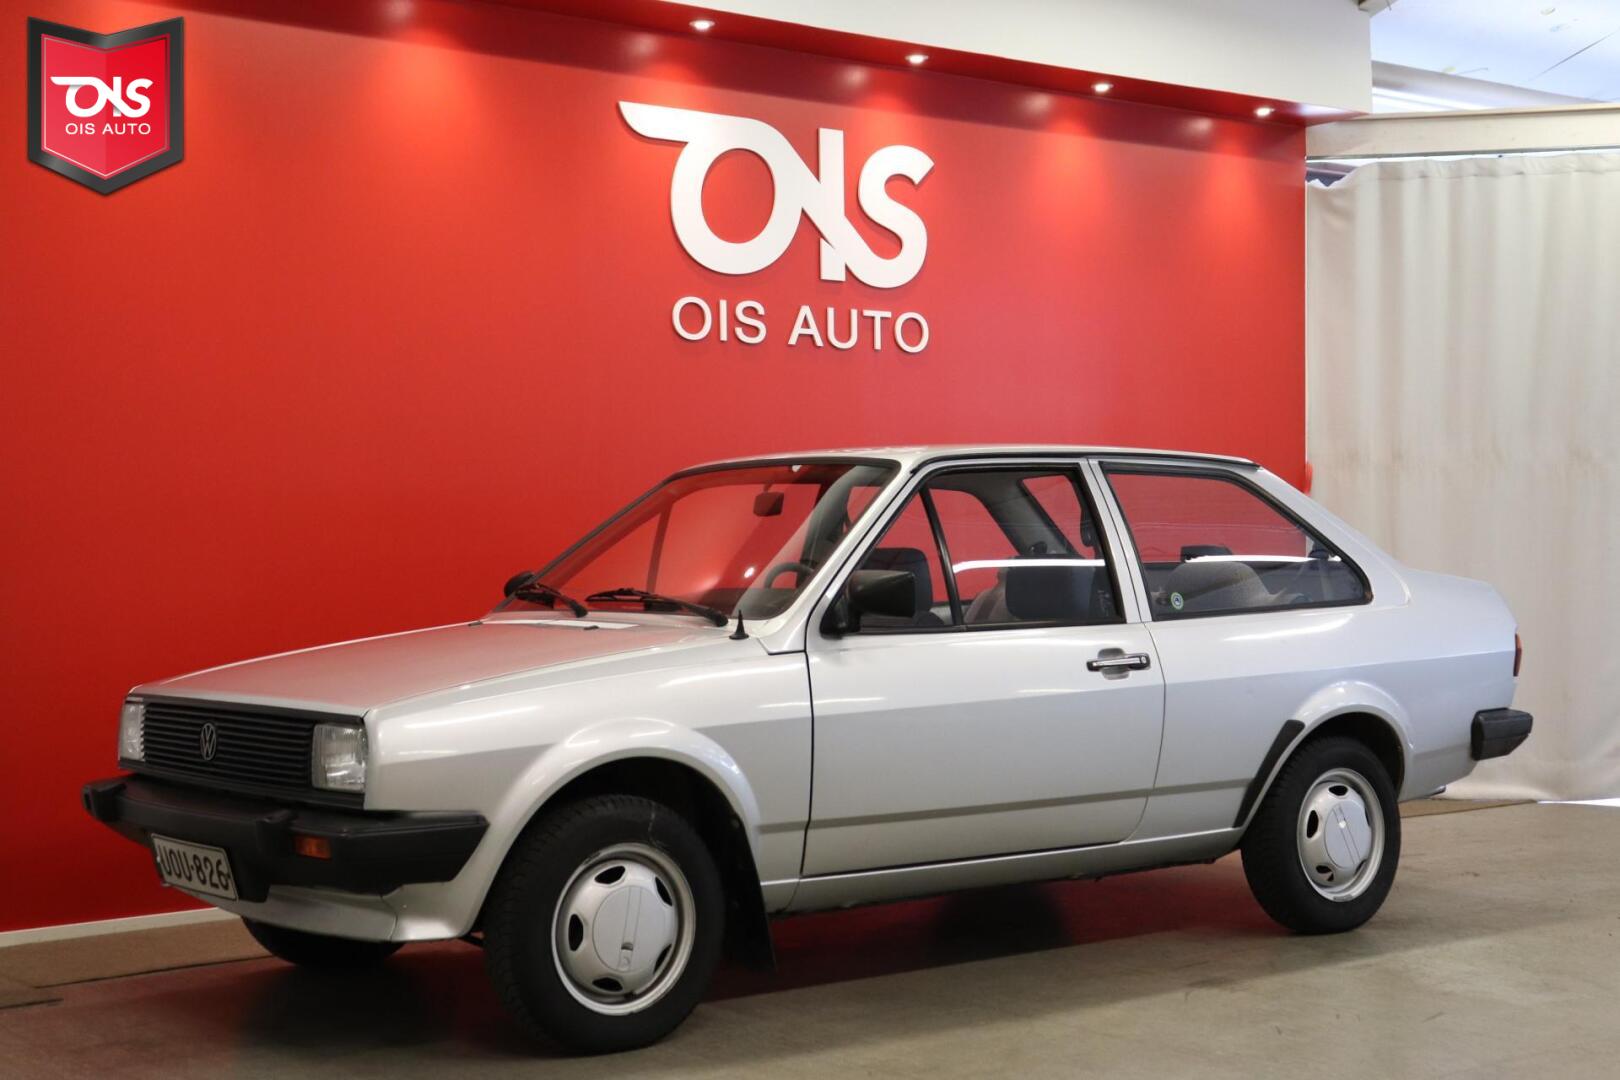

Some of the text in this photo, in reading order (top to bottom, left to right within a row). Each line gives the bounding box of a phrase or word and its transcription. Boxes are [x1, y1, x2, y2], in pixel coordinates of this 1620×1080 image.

[618, 100, 935, 289] OIS
[671, 296, 930, 353] OIS AUTO
